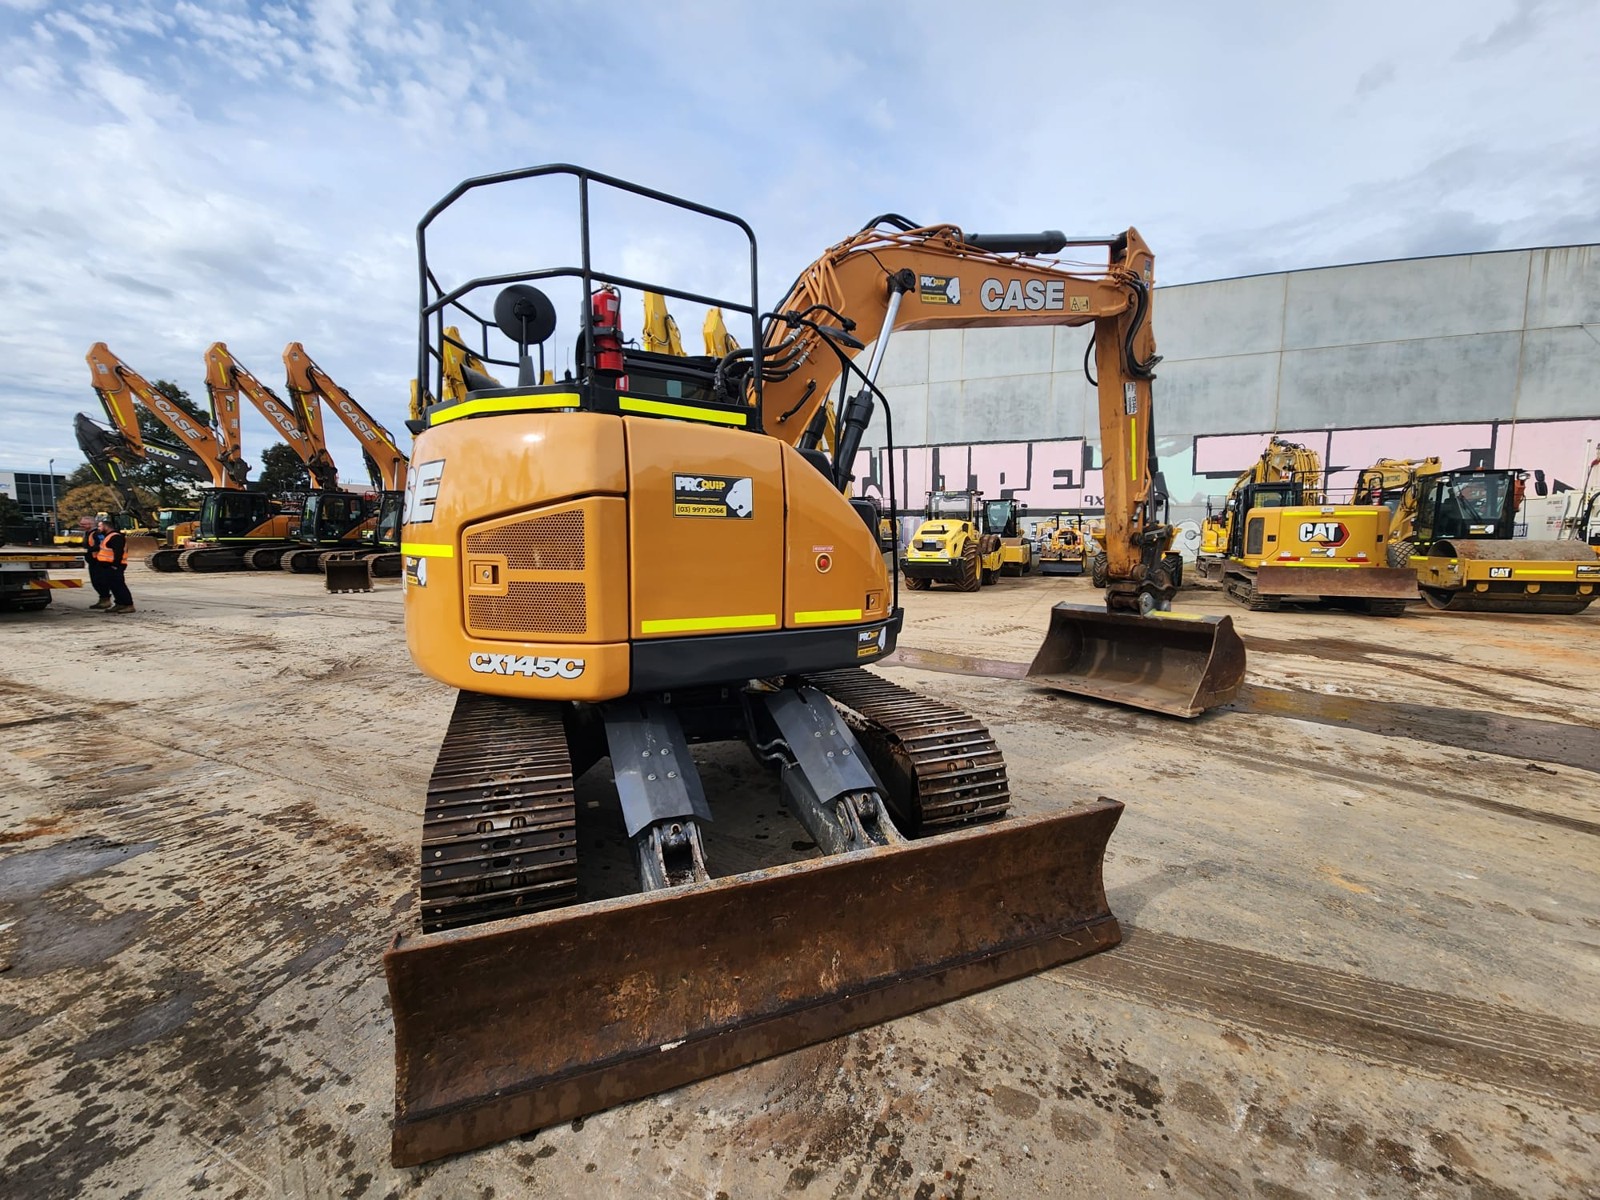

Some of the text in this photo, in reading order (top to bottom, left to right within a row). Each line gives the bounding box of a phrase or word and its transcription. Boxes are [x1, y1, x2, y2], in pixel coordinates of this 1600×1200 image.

[980, 278, 1065, 311] CASE
[155, 400, 201, 440] CASE
[263, 400, 302, 440] CASE
[340, 400, 382, 441] CASE
[143, 445, 180, 460] OLVO
[675, 476, 726, 492] PROQUIP
[677, 506, 691, 514] (03)
[1300, 523, 1339, 542] CAT
[1490, 567, 1511, 578] CAT
[469, 652, 586, 679] CX145C
